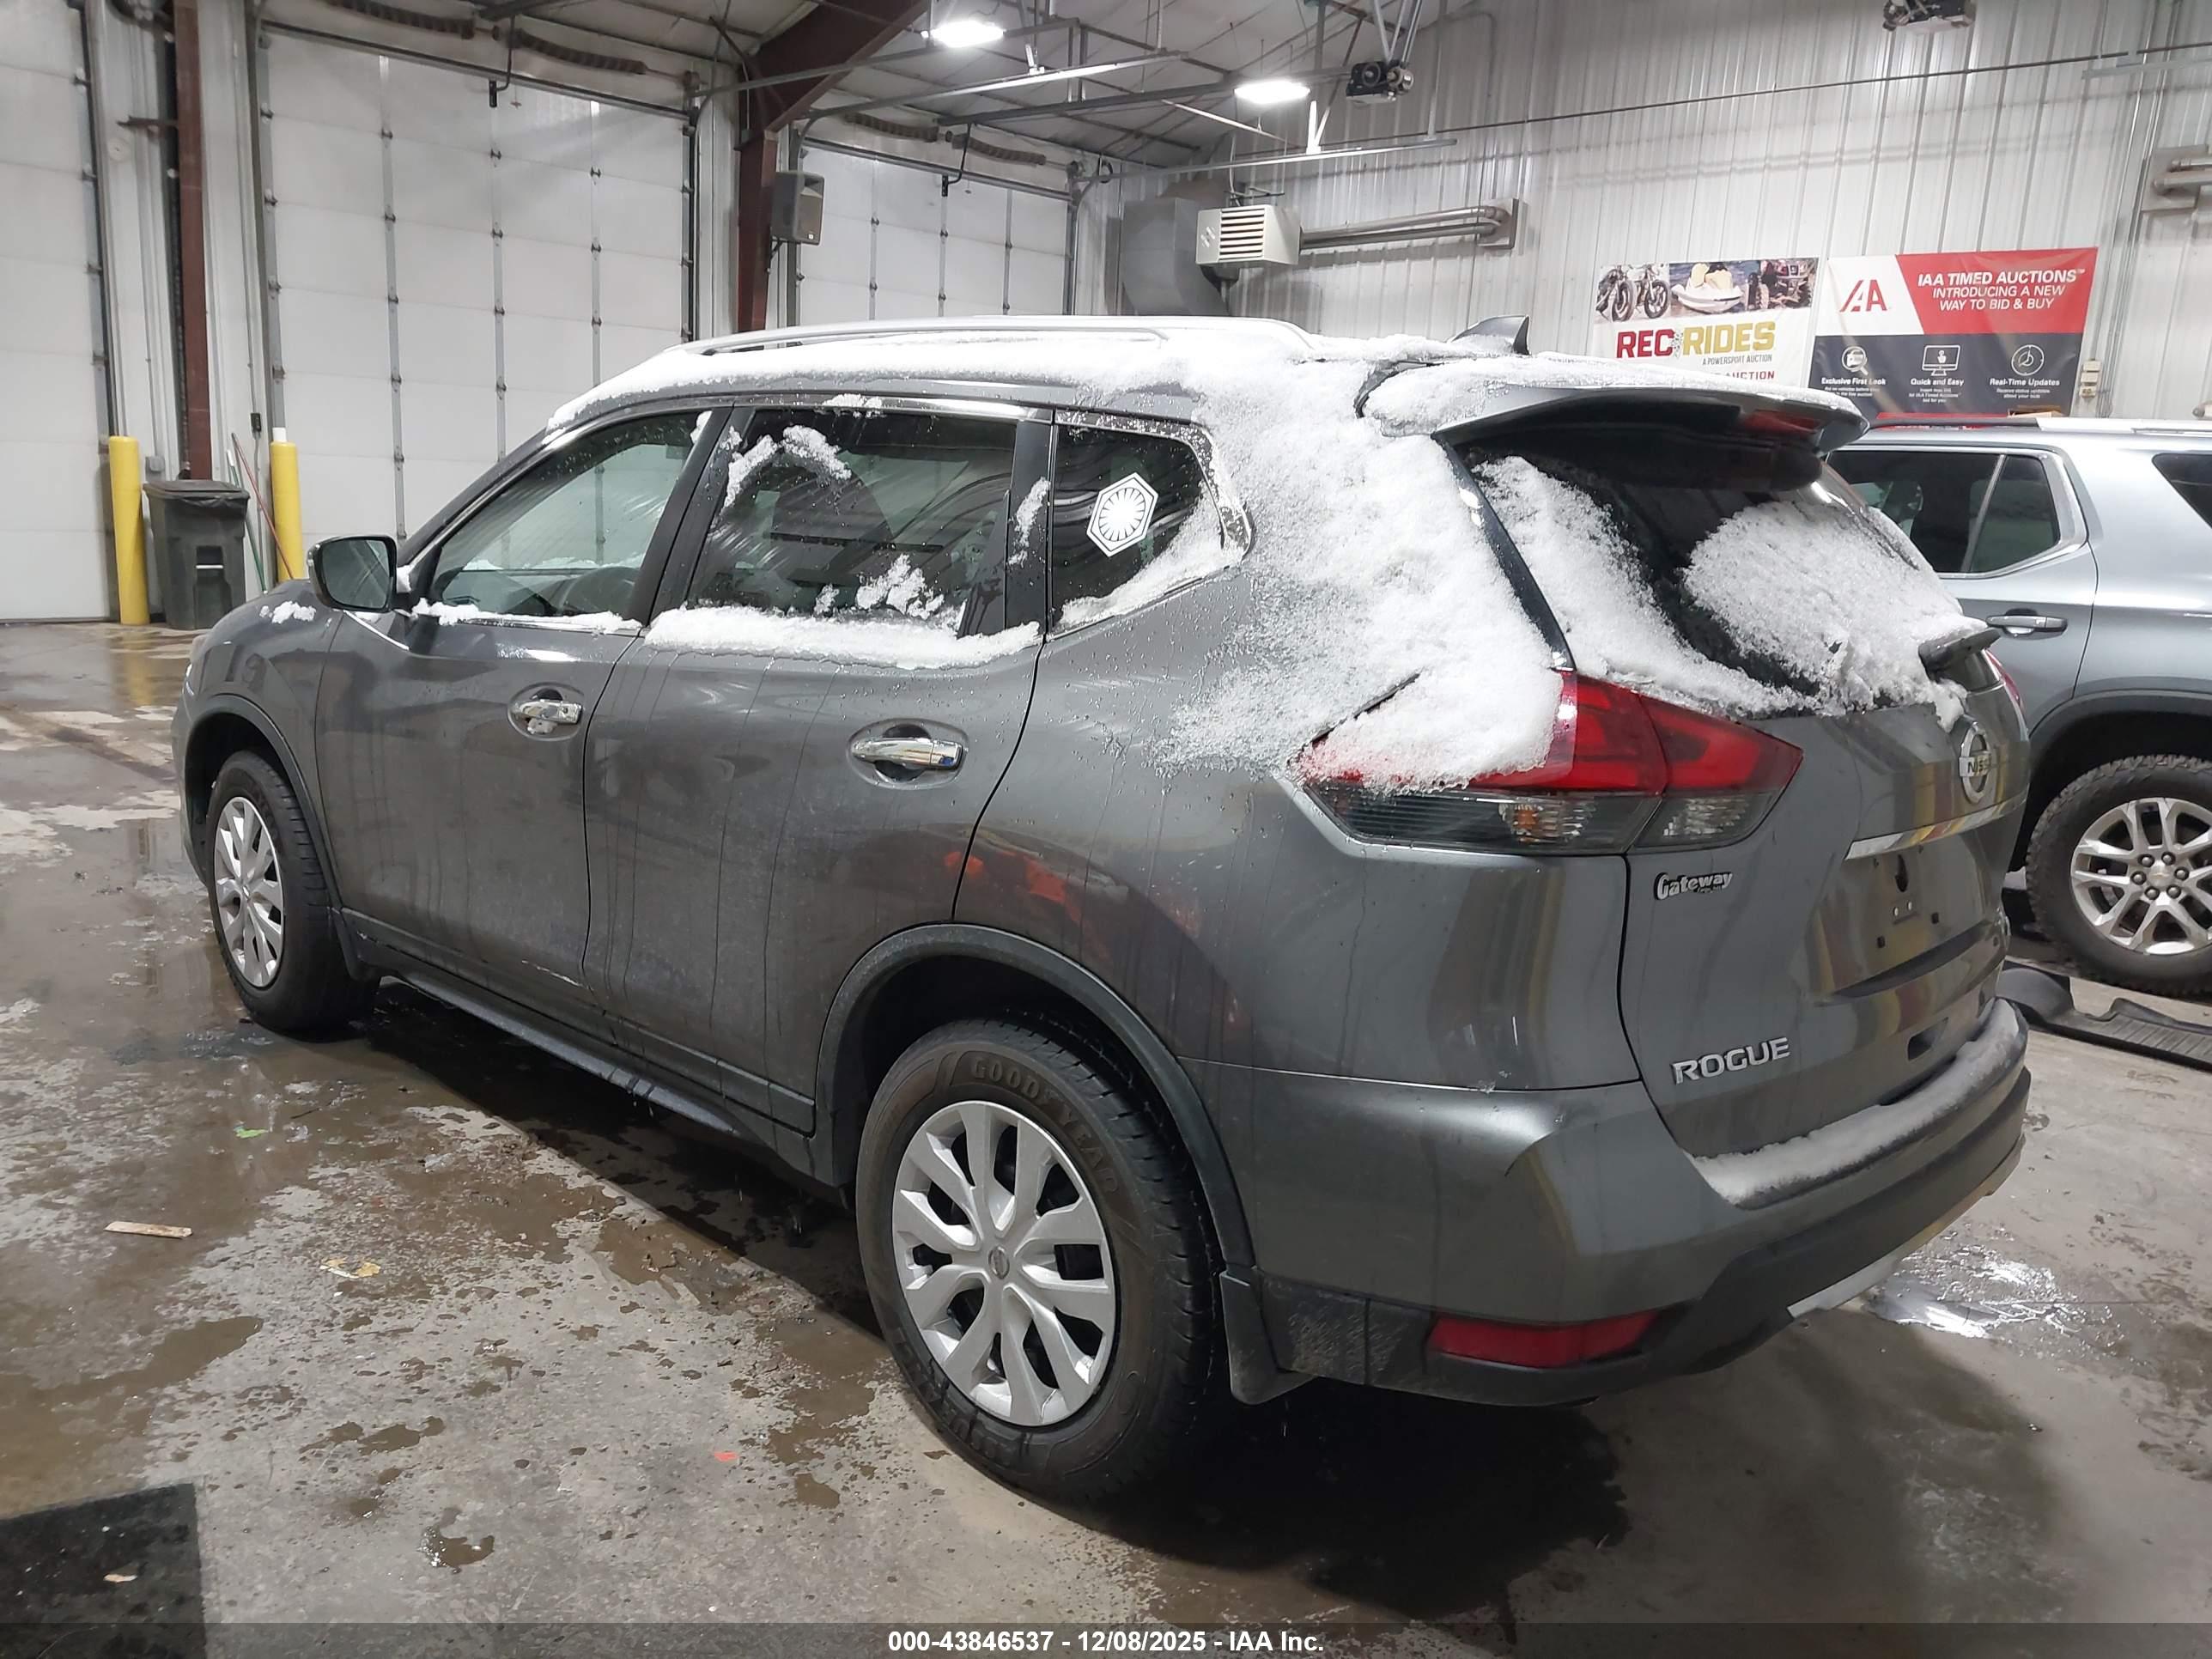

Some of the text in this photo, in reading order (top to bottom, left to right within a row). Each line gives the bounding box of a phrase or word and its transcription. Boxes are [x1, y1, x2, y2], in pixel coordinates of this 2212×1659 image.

[1917, 273, 1944, 287] IAA
[1948, 271, 1992, 286] TIMED
[1933, 284, 2065, 299] INTRODUCING A NEW
[1940, 297, 2054, 311] WAY TO BID & BUY
[1616, 321, 1776, 358] REC RIDES
[1746, 354, 1772, 363] AUCTION
[1948, 378, 1964, 386] Easy
[2028, 378, 2060, 387] Updates
[1655, 872, 1733, 900] Gateway
[1671, 1036, 1790, 1085] ROGUE
